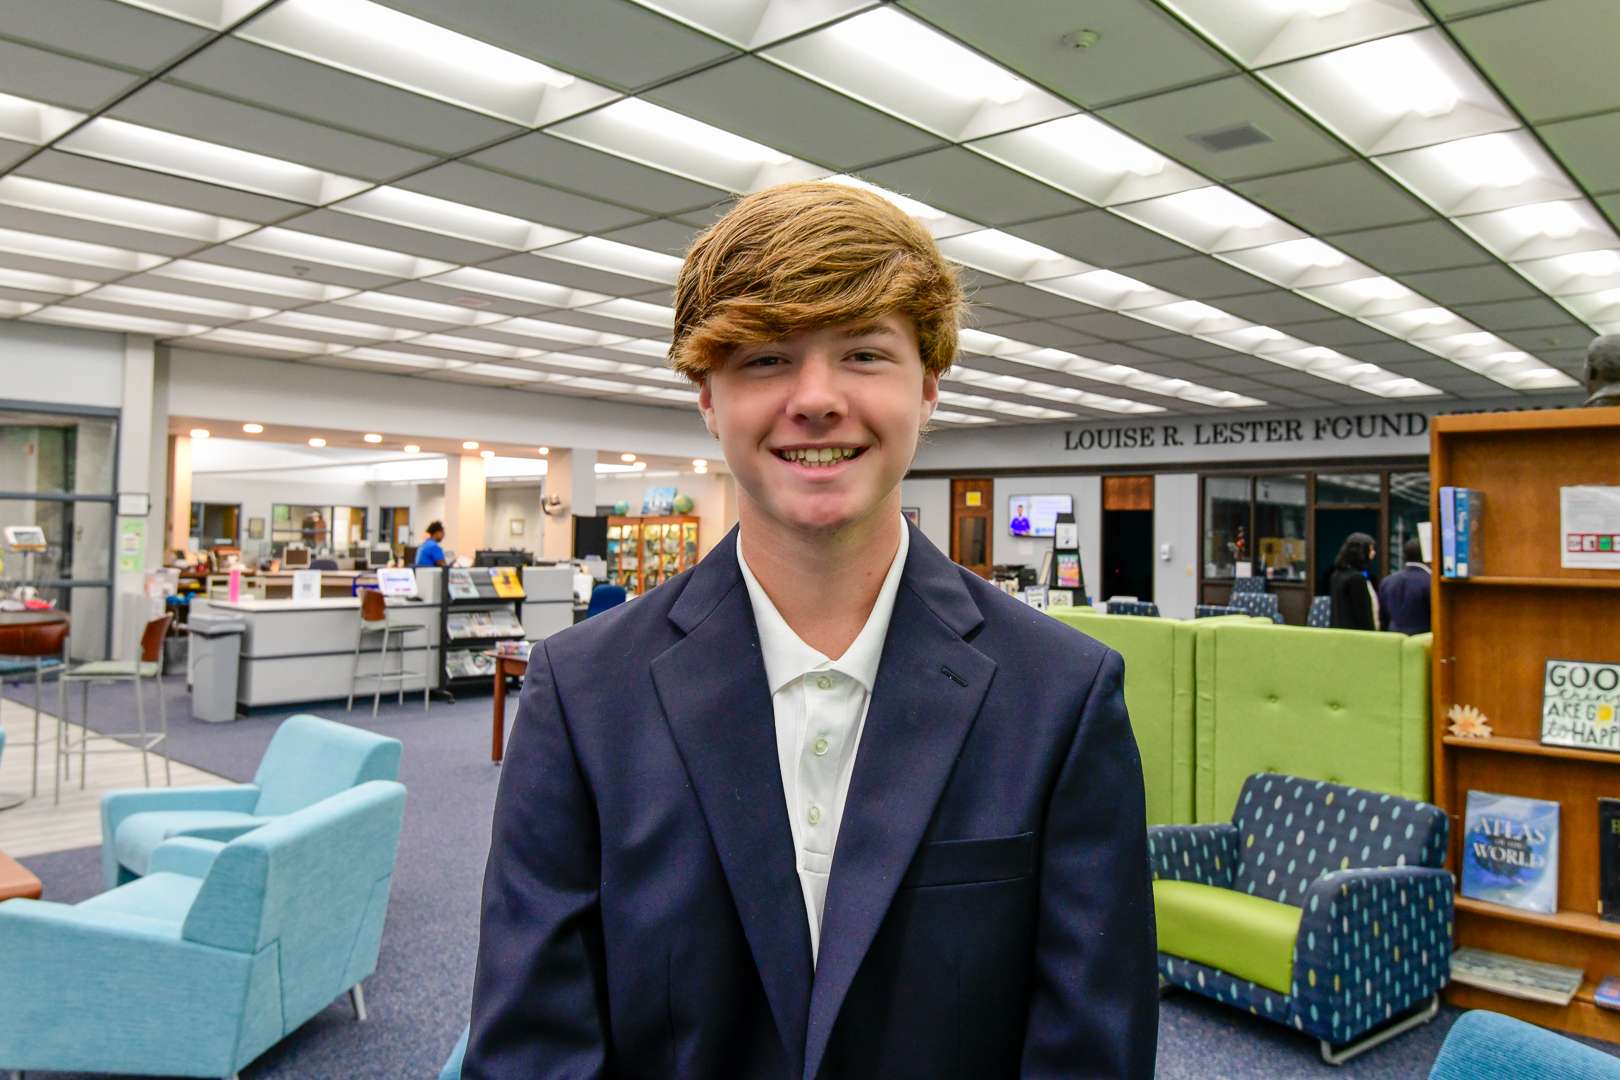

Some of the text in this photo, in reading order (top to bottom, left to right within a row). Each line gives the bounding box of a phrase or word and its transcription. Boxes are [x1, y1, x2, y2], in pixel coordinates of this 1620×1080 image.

[1064, 426, 1155, 451] LOUISE
[1162, 426, 1184, 447] R.
[1193, 418, 1304, 447] LESTER
[1549, 664, 1620, 691] GOO
[1547, 703, 1581, 720] ARE
[1571, 721, 1620, 747] HAPP
[1473, 814, 1546, 845] ATLAS
[1473, 842, 1546, 869] WORLD
